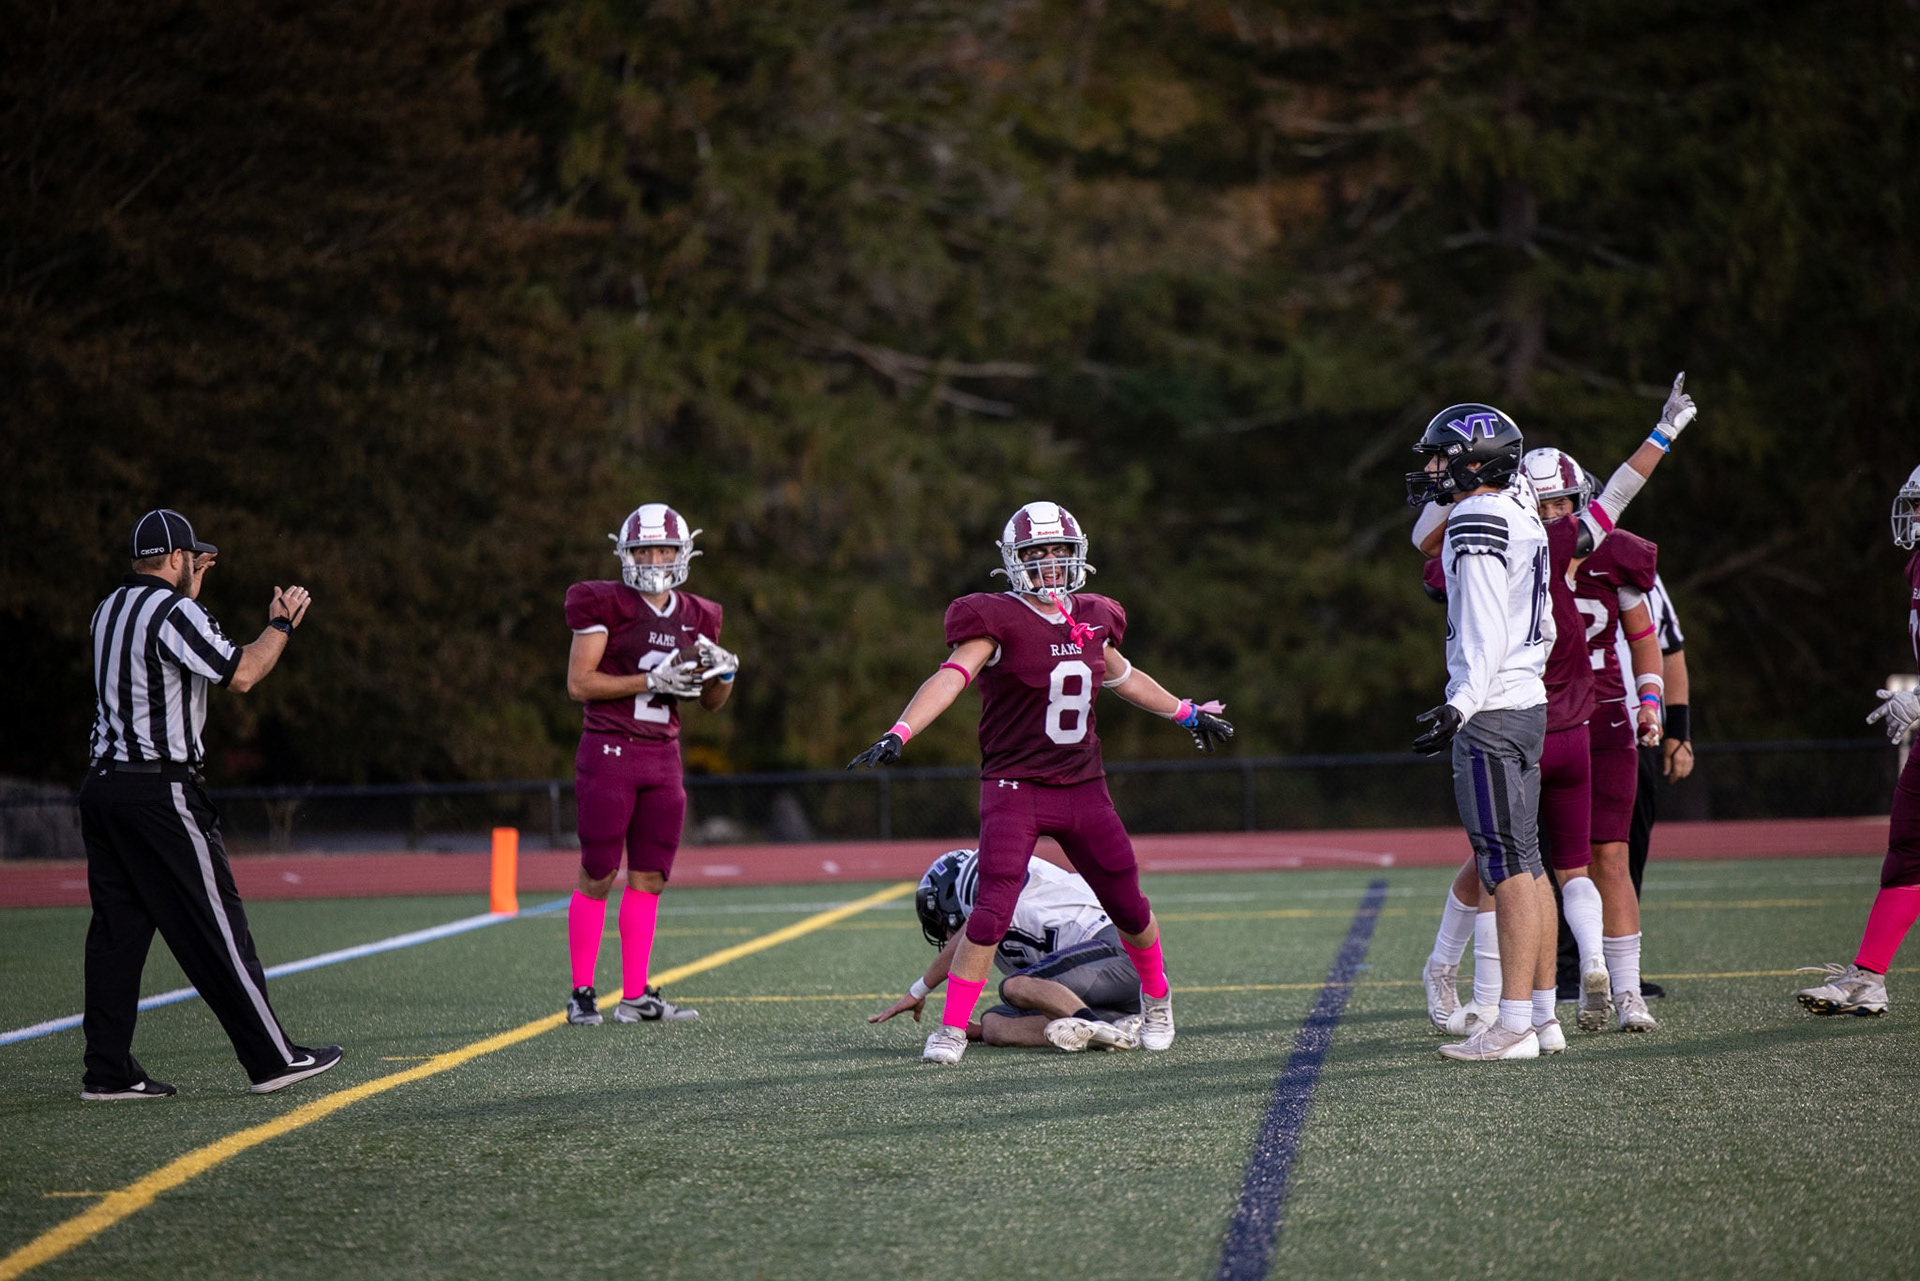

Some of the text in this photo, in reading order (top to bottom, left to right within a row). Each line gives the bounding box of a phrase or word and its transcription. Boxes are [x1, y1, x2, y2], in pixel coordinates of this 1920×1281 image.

[1447, 413, 1498, 441] VT
[648, 631, 676, 648] RAMS
[1050, 643, 1083, 656] RAMS
[634, 650, 670, 724] 2
[1045, 660, 1092, 744] 8
